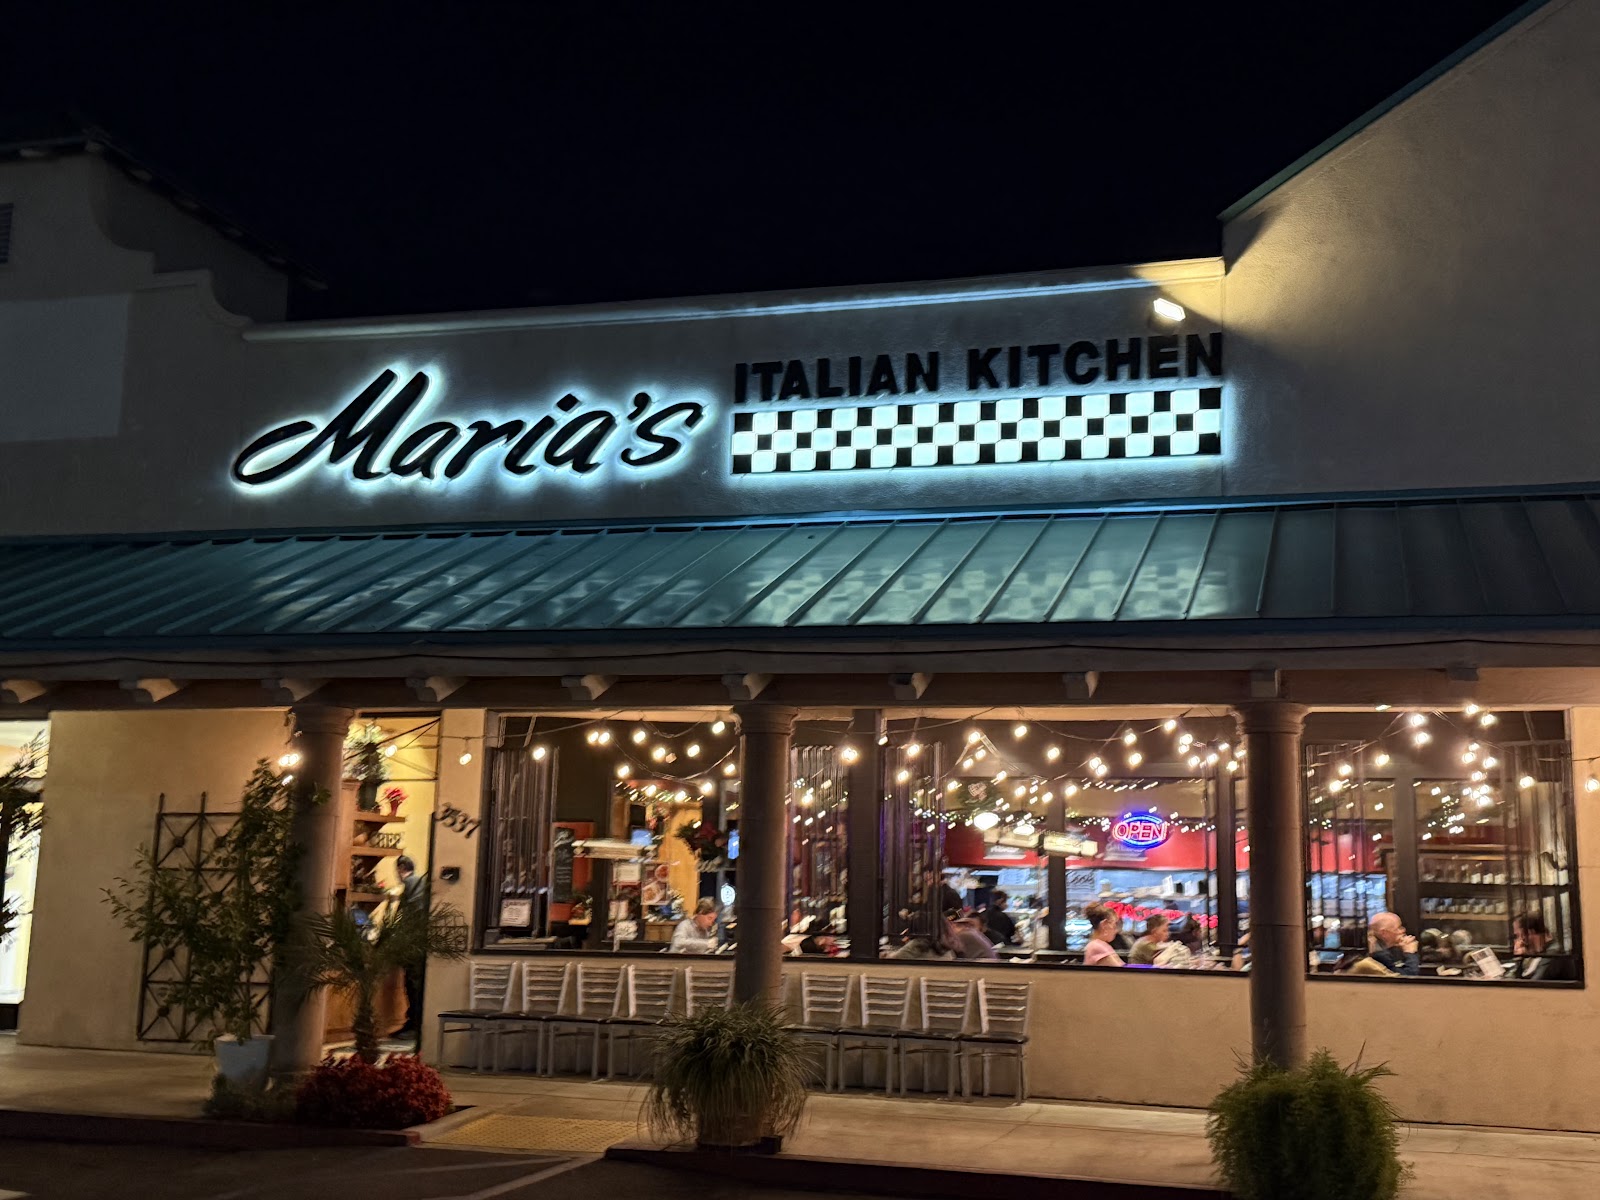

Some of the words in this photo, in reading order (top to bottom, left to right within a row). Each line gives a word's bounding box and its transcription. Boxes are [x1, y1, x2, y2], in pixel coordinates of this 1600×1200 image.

[734, 351, 939, 403] ITALIAN
[967, 332, 1223, 392] KITCHEN
[233, 367, 704, 484] Maria's
[1112, 820, 1168, 841] OPEN
